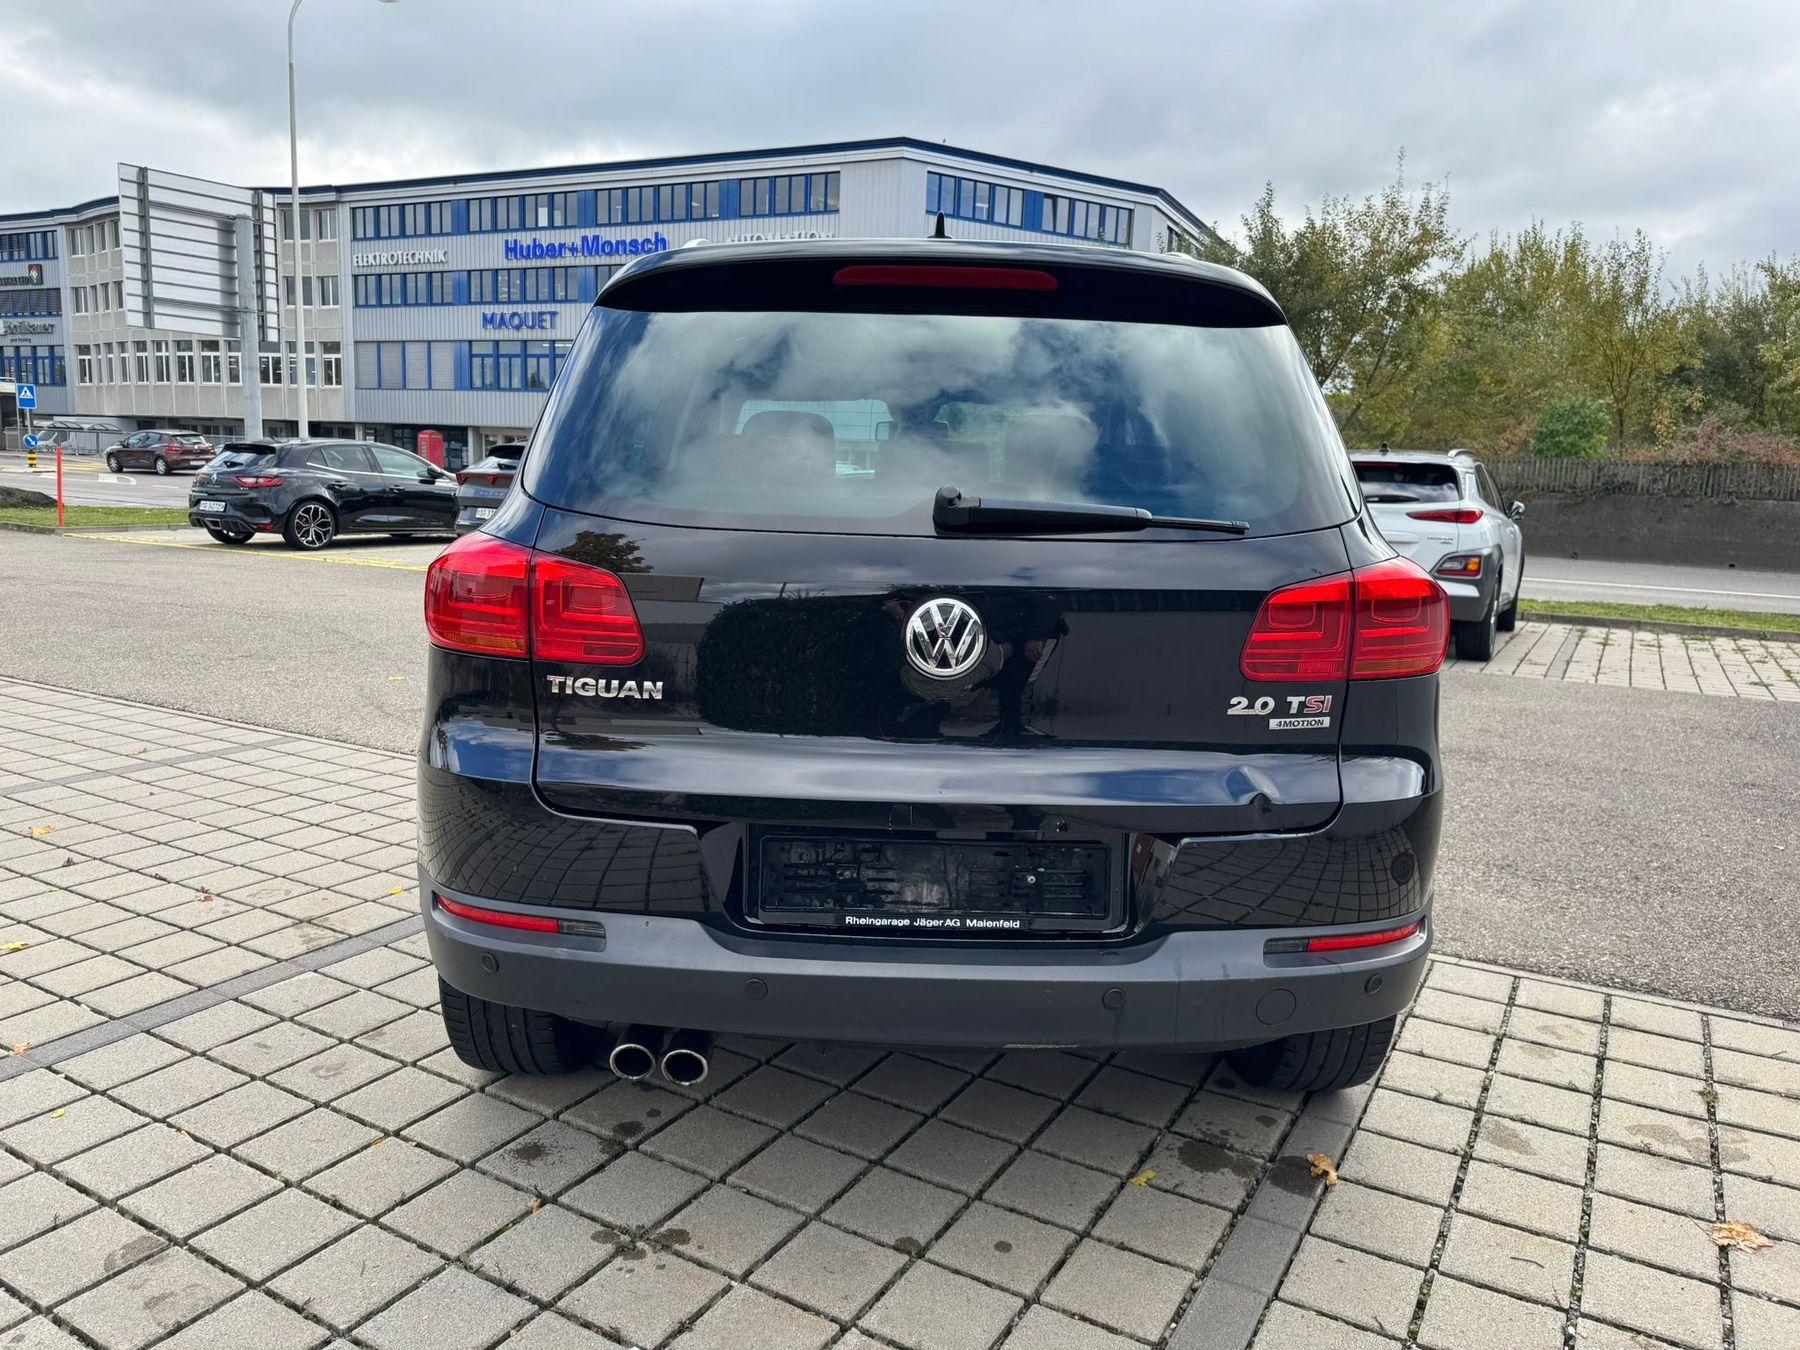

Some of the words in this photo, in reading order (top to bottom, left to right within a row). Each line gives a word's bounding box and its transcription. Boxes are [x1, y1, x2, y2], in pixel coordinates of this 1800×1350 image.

[504, 231, 668, 260] Huber+Monsch
[353, 248, 448, 267] ELEKTROTECHNIK
[482, 310, 559, 331] MAQUET
[546, 674, 664, 700] TIGUAN
[1286, 694, 1333, 714] TSI
[1275, 719, 1325, 729] 4MOTION
[845, 916, 910, 927] Rheingarage
[944, 918, 961, 927] AG
[966, 918, 1020, 929] Maienfeld
